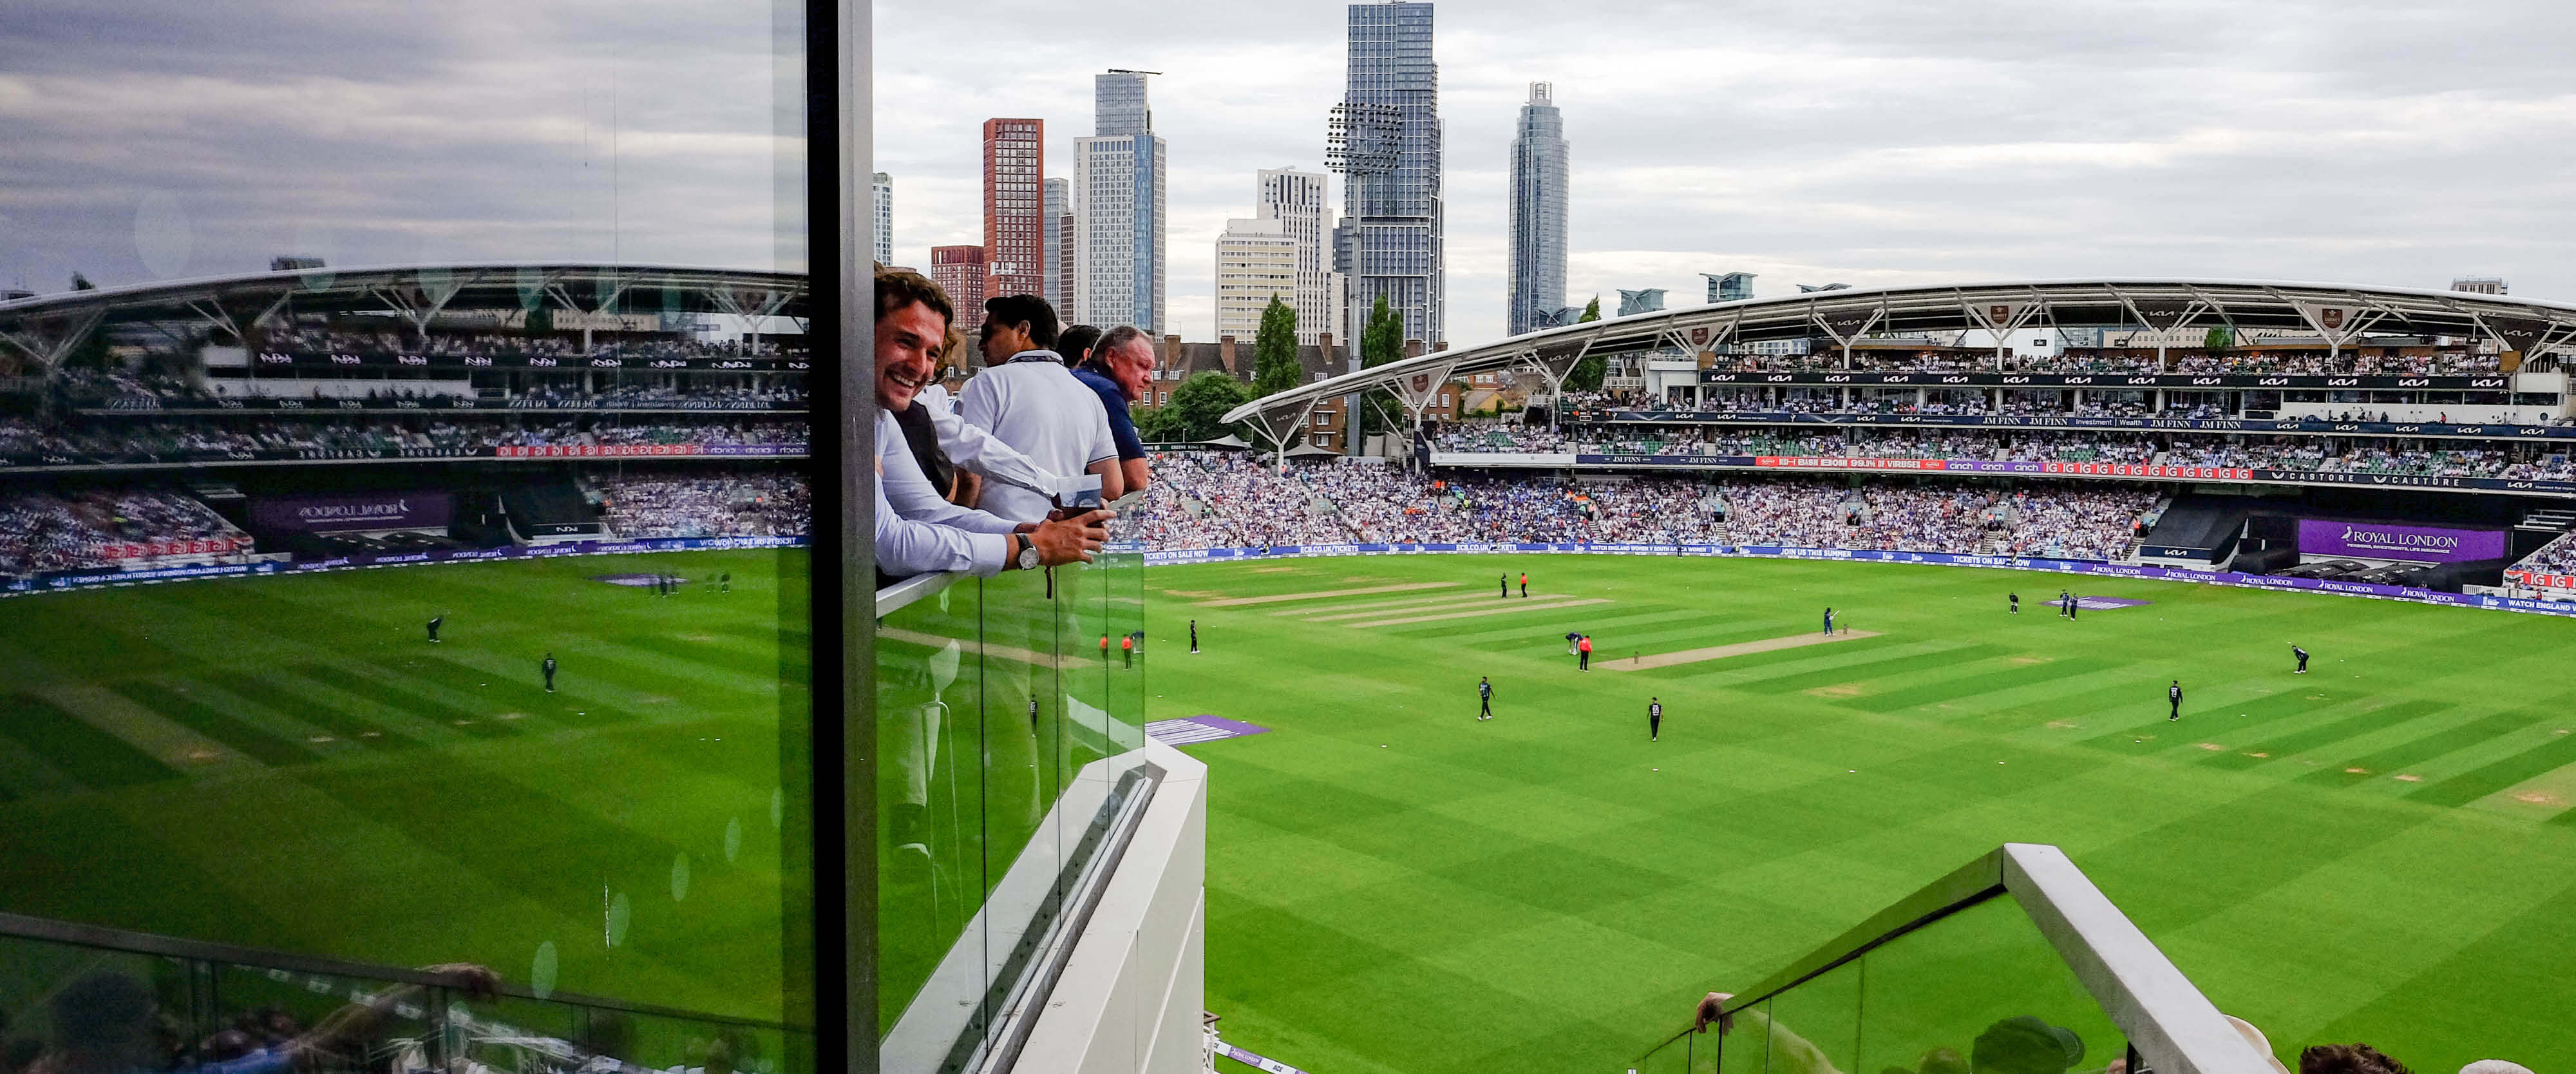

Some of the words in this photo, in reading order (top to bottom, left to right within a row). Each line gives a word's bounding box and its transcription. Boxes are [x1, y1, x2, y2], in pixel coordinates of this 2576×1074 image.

[2168, 419, 2190, 428] FINN
[2217, 420, 2241, 428] FINN
[2046, 463, 2058, 472] IG
[2063, 463, 2074, 472] IG
[2079, 464, 2091, 472] IG
[2096, 465, 2108, 473] IG
[2114, 465, 2125, 474] IG
[2130, 466, 2143, 475] IG
[2148, 466, 2160, 475] IG
[2165, 467, 2177, 476] IG
[2183, 468, 2195, 477] IG
[2201, 468, 2213, 478] IG
[2219, 469, 2231, 479] IG
[2236, 470, 2249, 479] IG
[2289, 472, 2354, 482] CASTORE
[2392, 477, 2459, 486] CASTORE
[2354, 531, 2395, 544] ROYAL
[2399, 533, 2458, 548] LONDON
[1144, 551, 1167, 560] TICKETS
[1194, 549, 1209, 557] NOW
[1953, 555, 1980, 564] TICKETS
[2530, 574, 2545, 585] IG
[2551, 576, 2566, 587] IG
[2324, 583, 2344, 591] ROYAL
[2407, 590, 2426, 598] ROYAL
[2425, 593, 2455, 602] LONDON
[2508, 599, 2535, 608] WATCH
[2536, 601, 2571, 611] ENGLAND
